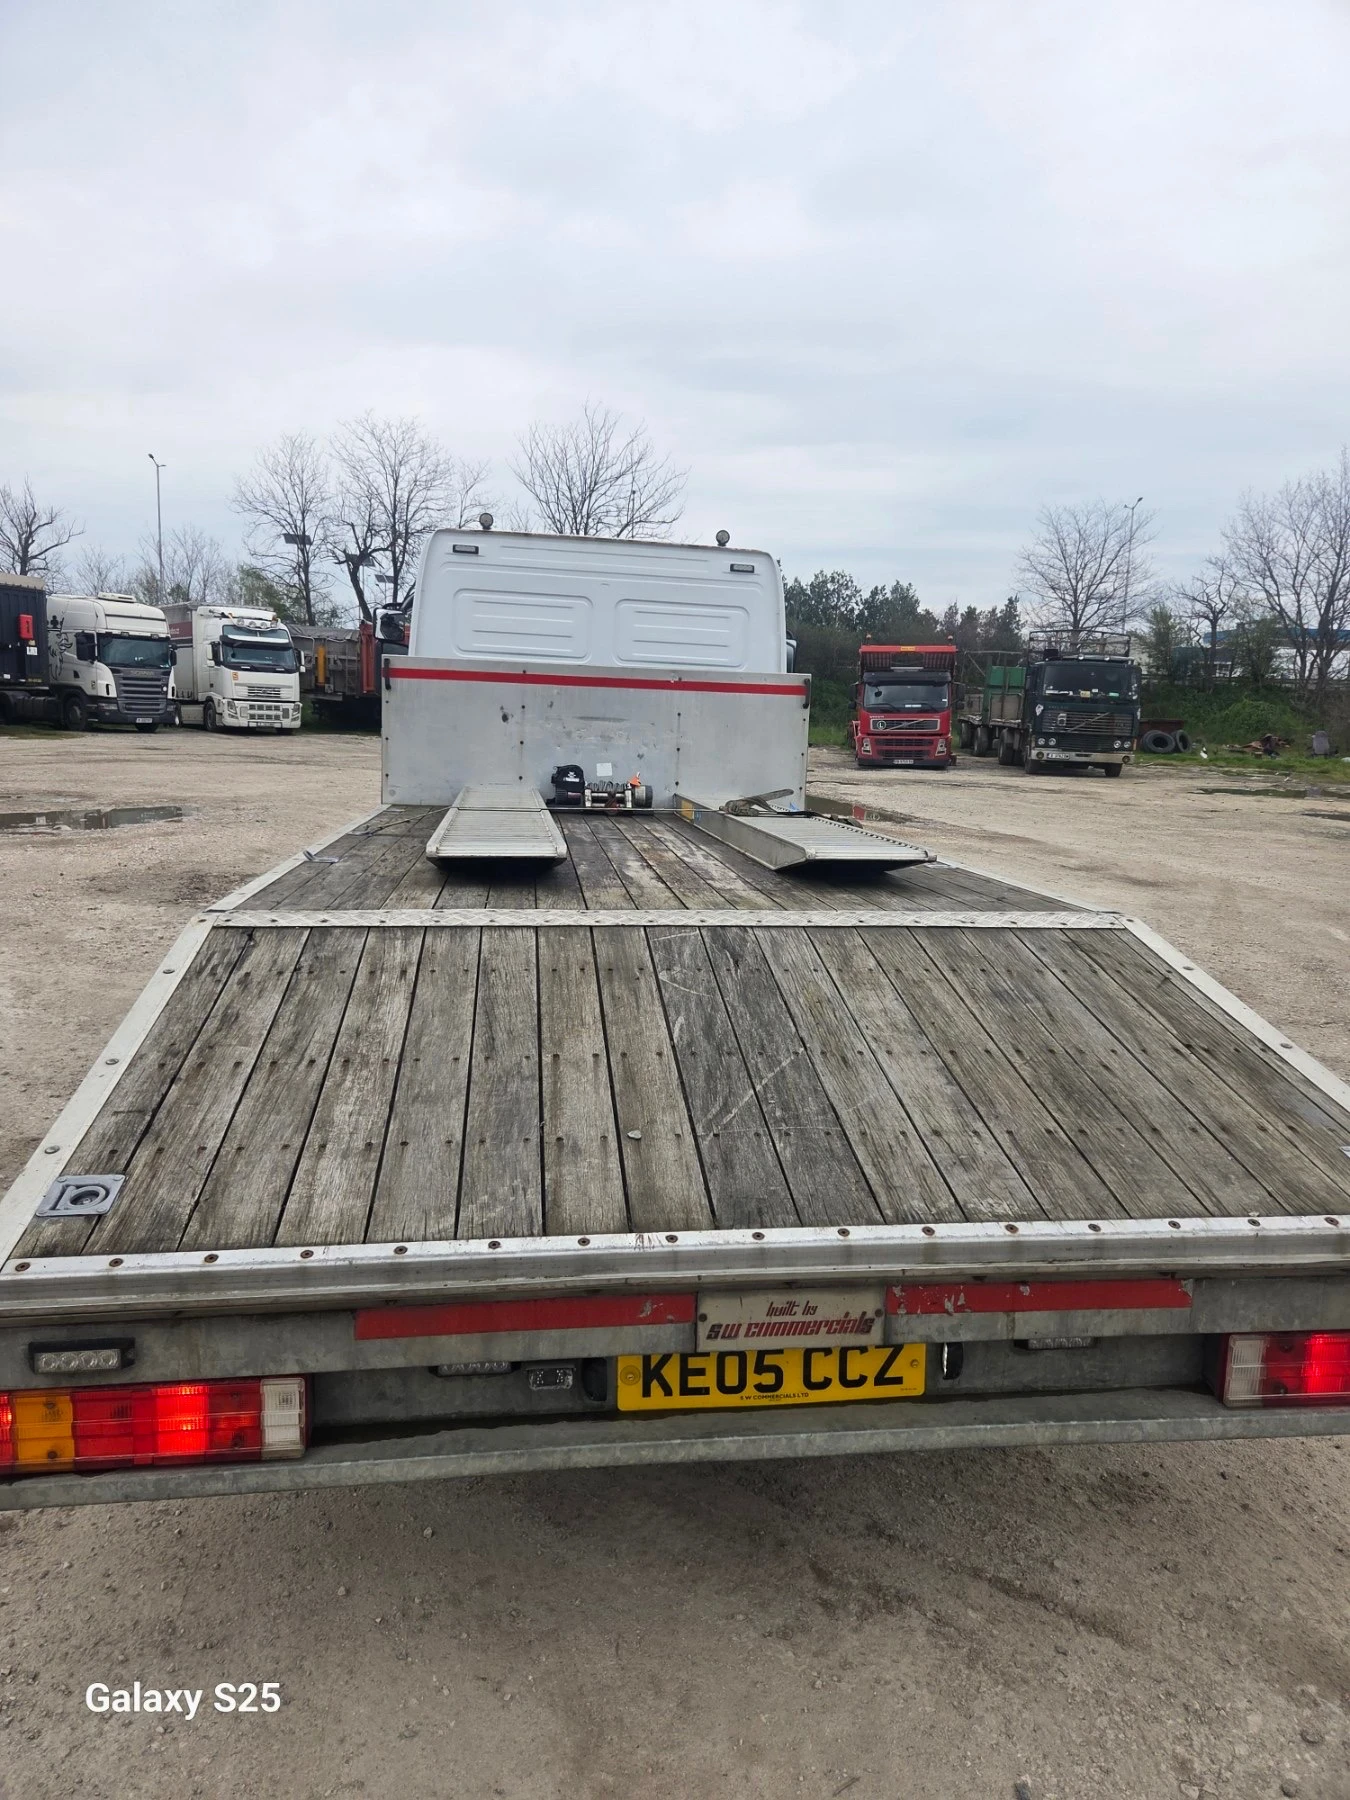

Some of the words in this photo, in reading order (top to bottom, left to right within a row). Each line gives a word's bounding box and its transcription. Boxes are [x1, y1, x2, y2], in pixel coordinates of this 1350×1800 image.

[766, 1301, 800, 1317] built
[802, 1300, 818, 1316] by
[642, 1349, 784, 1398] KE05
[803, 1344, 904, 1391] CCZ
